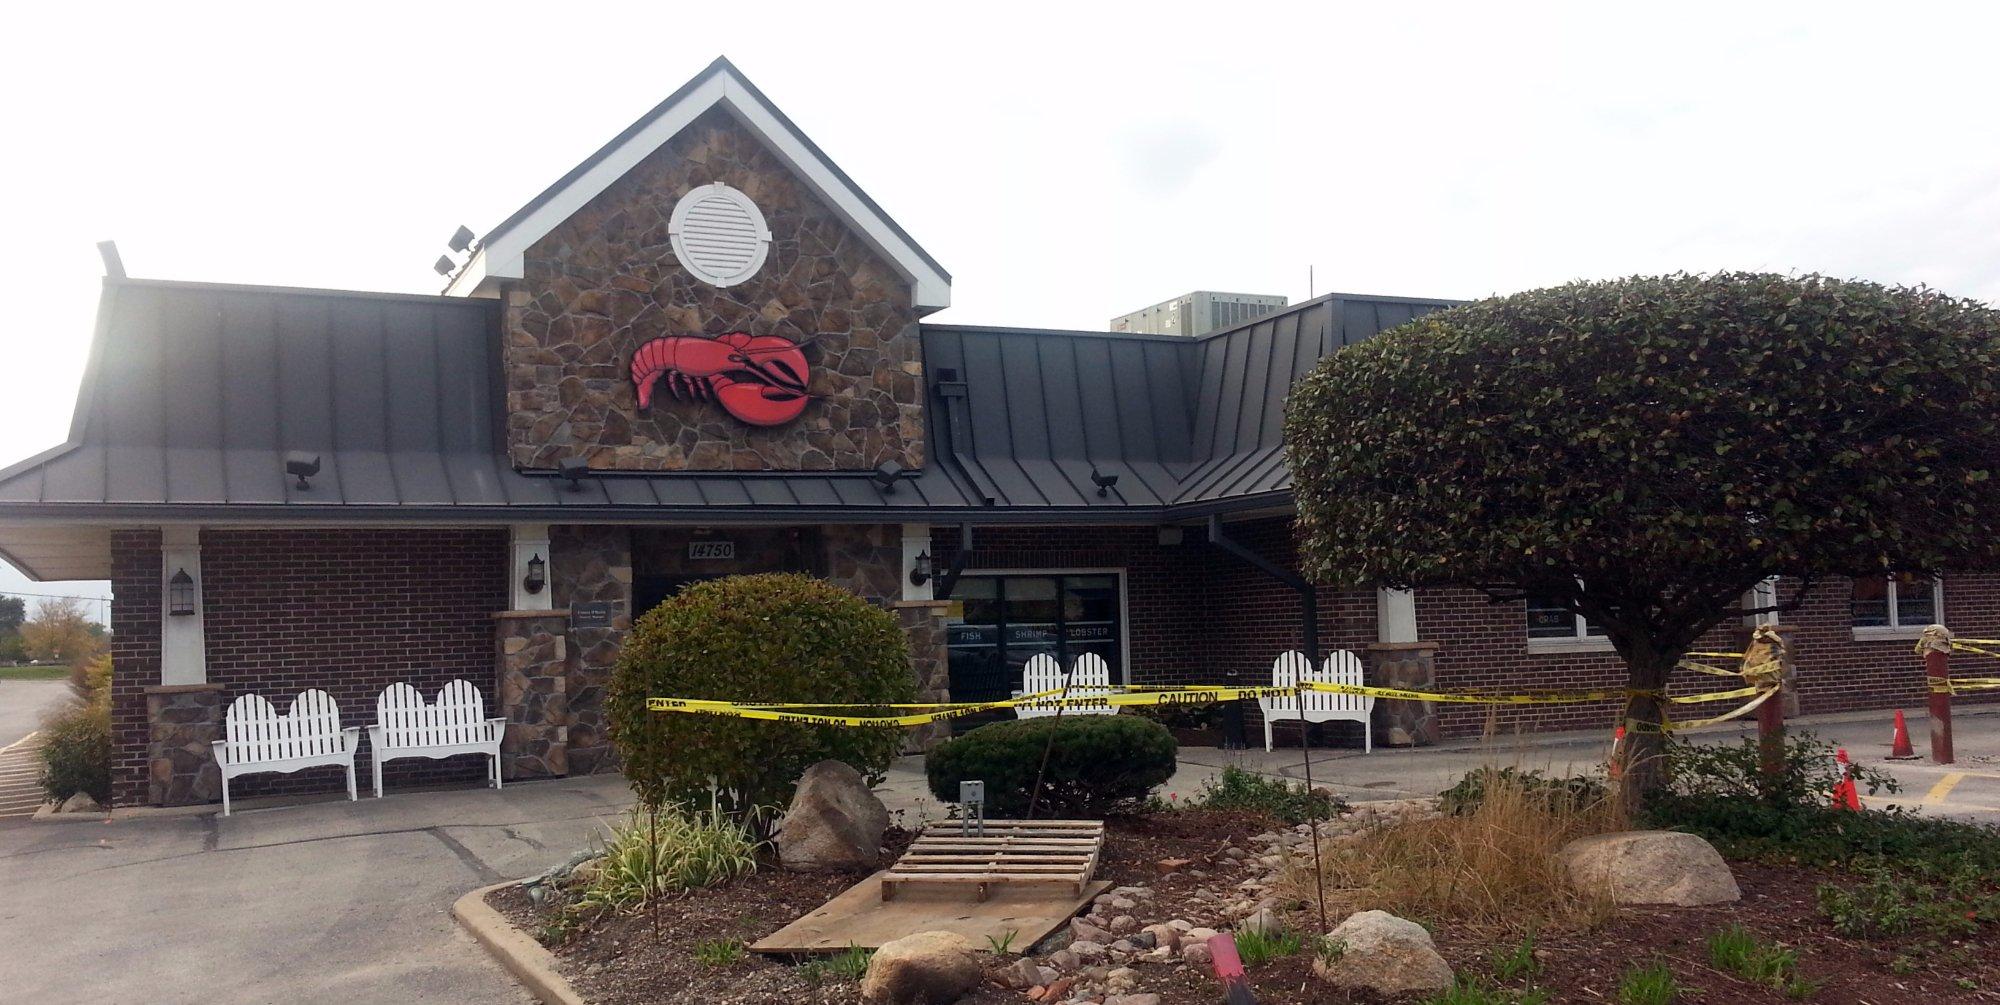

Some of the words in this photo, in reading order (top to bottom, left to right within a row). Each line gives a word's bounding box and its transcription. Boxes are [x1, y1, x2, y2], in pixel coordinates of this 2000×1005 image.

[692, 543, 732, 557] 14750
[961, 632, 981, 640] FISH
[1015, 630, 1048, 639] SHRIMP
[1070, 627, 1108, 637] LOBSTER
[1158, 691, 1218, 704] CAUTION
[1238, 689, 1257, 699] DO
[1262, 688, 1289, 697] NOT
[648, 699, 687, 707] ENTER
[1066, 697, 1108, 706] ENTER
